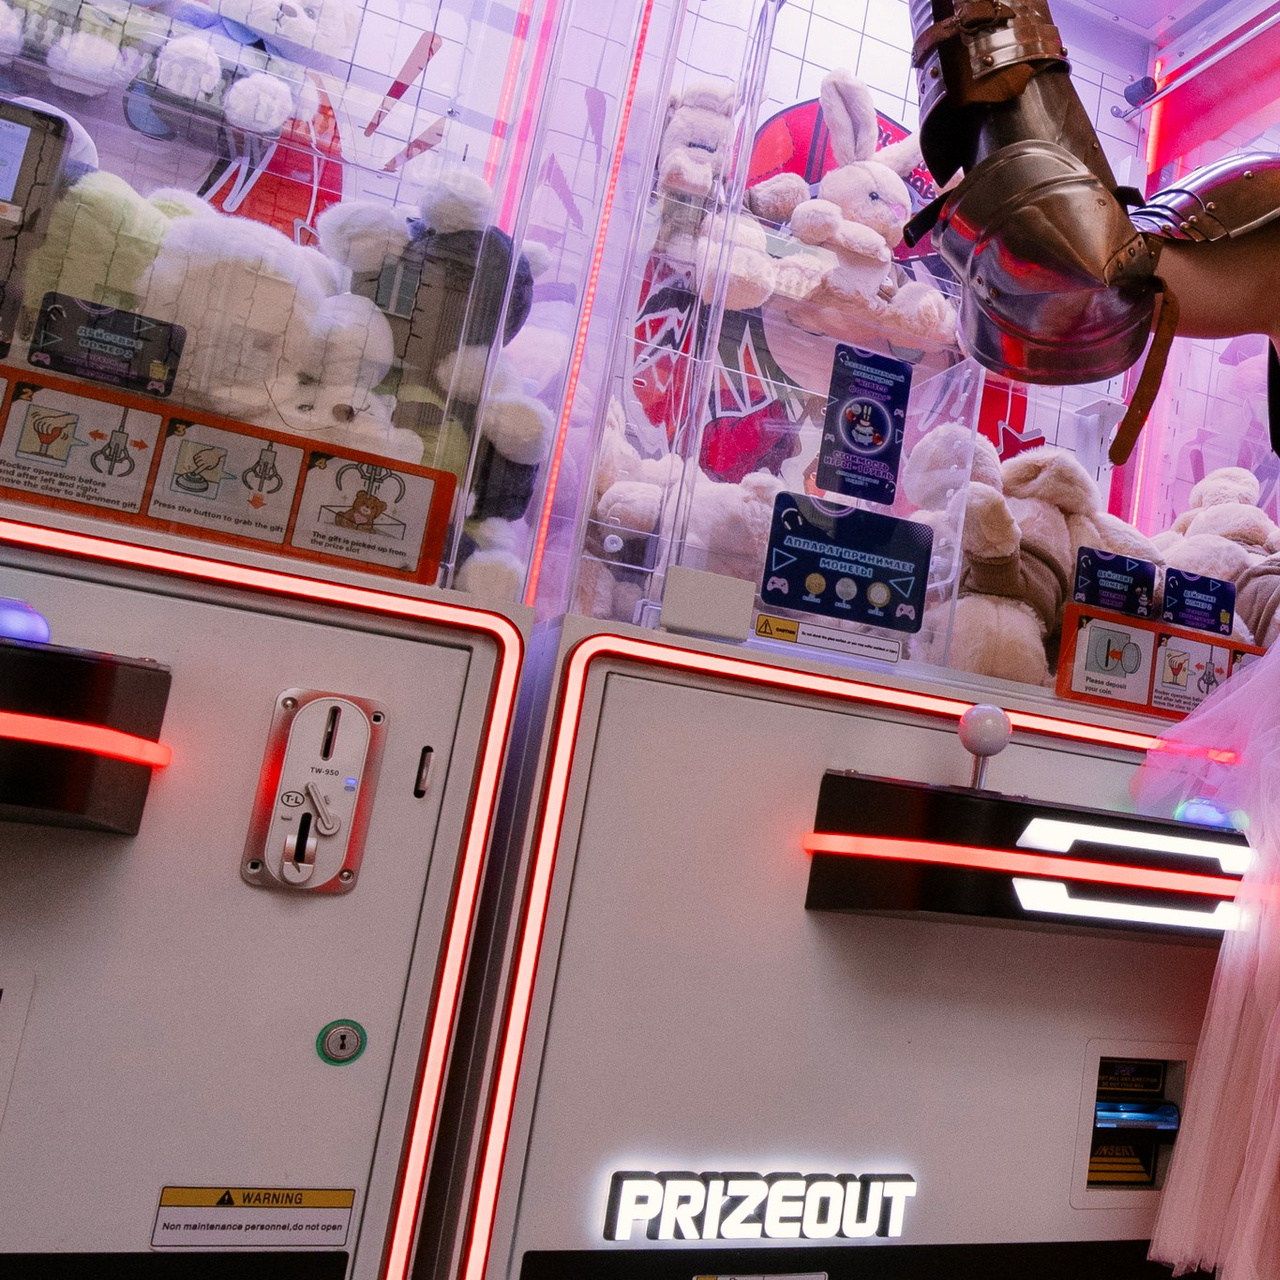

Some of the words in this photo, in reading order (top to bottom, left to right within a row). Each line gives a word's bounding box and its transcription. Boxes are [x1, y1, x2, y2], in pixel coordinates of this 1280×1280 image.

[21, 388, 34, 400] 2
[174, 424, 186, 437] 3
[315, 458, 327, 470] 4
[824, 456, 852, 470] ИГРЫ
[833, 450, 889, 471] СТОИМОСТЬ
[17, 472, 38, 481] after
[41, 476, 55, 485] left
[58, 479, 74, 489] and
[33, 468, 76, 481] operation
[79, 476, 106, 488] before
[24, 480, 38, 489] the
[41, 484, 62, 493] claw
[64, 488, 73, 496] to
[76, 491, 120, 505] alignment
[154, 500, 176, 510] Press
[178, 505, 192, 513] the
[194, 508, 221, 520] button
[224, 514, 232, 522] to
[234, 516, 252, 527] grab
[255, 521, 268, 530] the
[270, 525, 283, 533] gift
[311, 538, 323, 546] the
[324, 542, 344, 551] prize
[345, 545, 360, 554] slot
[312, 531, 326, 540] The
[328, 534, 342, 544] gift
[351, 540, 376, 551] picked
[378, 545, 387, 553] up
[389, 548, 407, 557] from
[784, 535, 842, 556] АППАРАТ
[842, 549, 915, 573] ПРИНИМАЕТ
[820, 558, 873, 578] МОНЕТЫ
[1162, 637, 1167, 647] 2
[1086, 676, 1105, 685] Please
[1106, 680, 1127, 689] deposit
[311, 767, 339, 776] TW-950
[285, 795, 300, 804] T-L
[1095, 1145, 1135, 1156] INSERT
[242, 1193, 303, 1205] WARNING
[613, 1177, 917, 1240] PRIZEOUT
[162, 1222, 181, 1231] Non
[183, 1222, 243, 1231] maintenance
[305, 1223, 320, 1231] not
[321, 1224, 342, 1232] open
